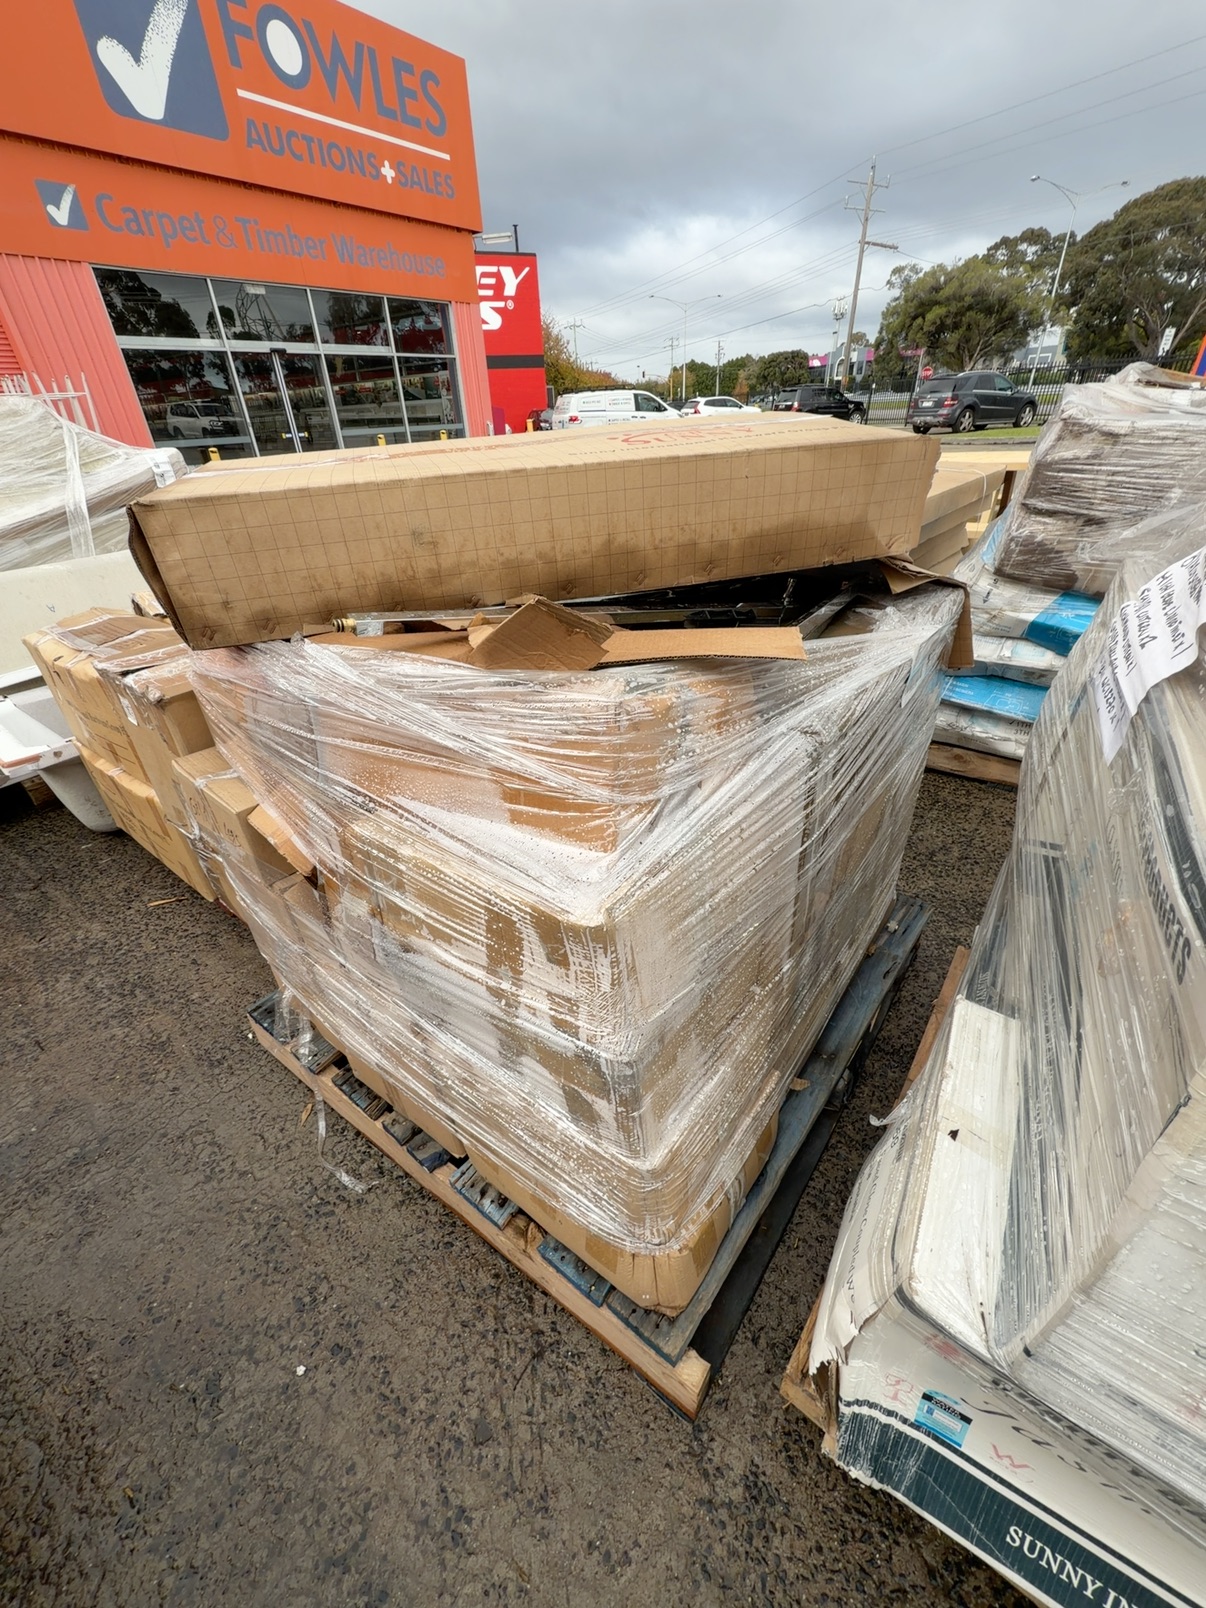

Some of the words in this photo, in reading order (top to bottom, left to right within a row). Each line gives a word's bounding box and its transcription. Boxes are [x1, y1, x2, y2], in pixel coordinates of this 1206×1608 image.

[216, 0, 448, 138] FOWLES
[95, 192, 211, 249] Carpet
[214, 215, 239, 250] &
[235, 217, 327, 262] Timber
[330, 233, 446, 279] Warehouse
[1005, 1525, 1104, 1600] SUNNY
